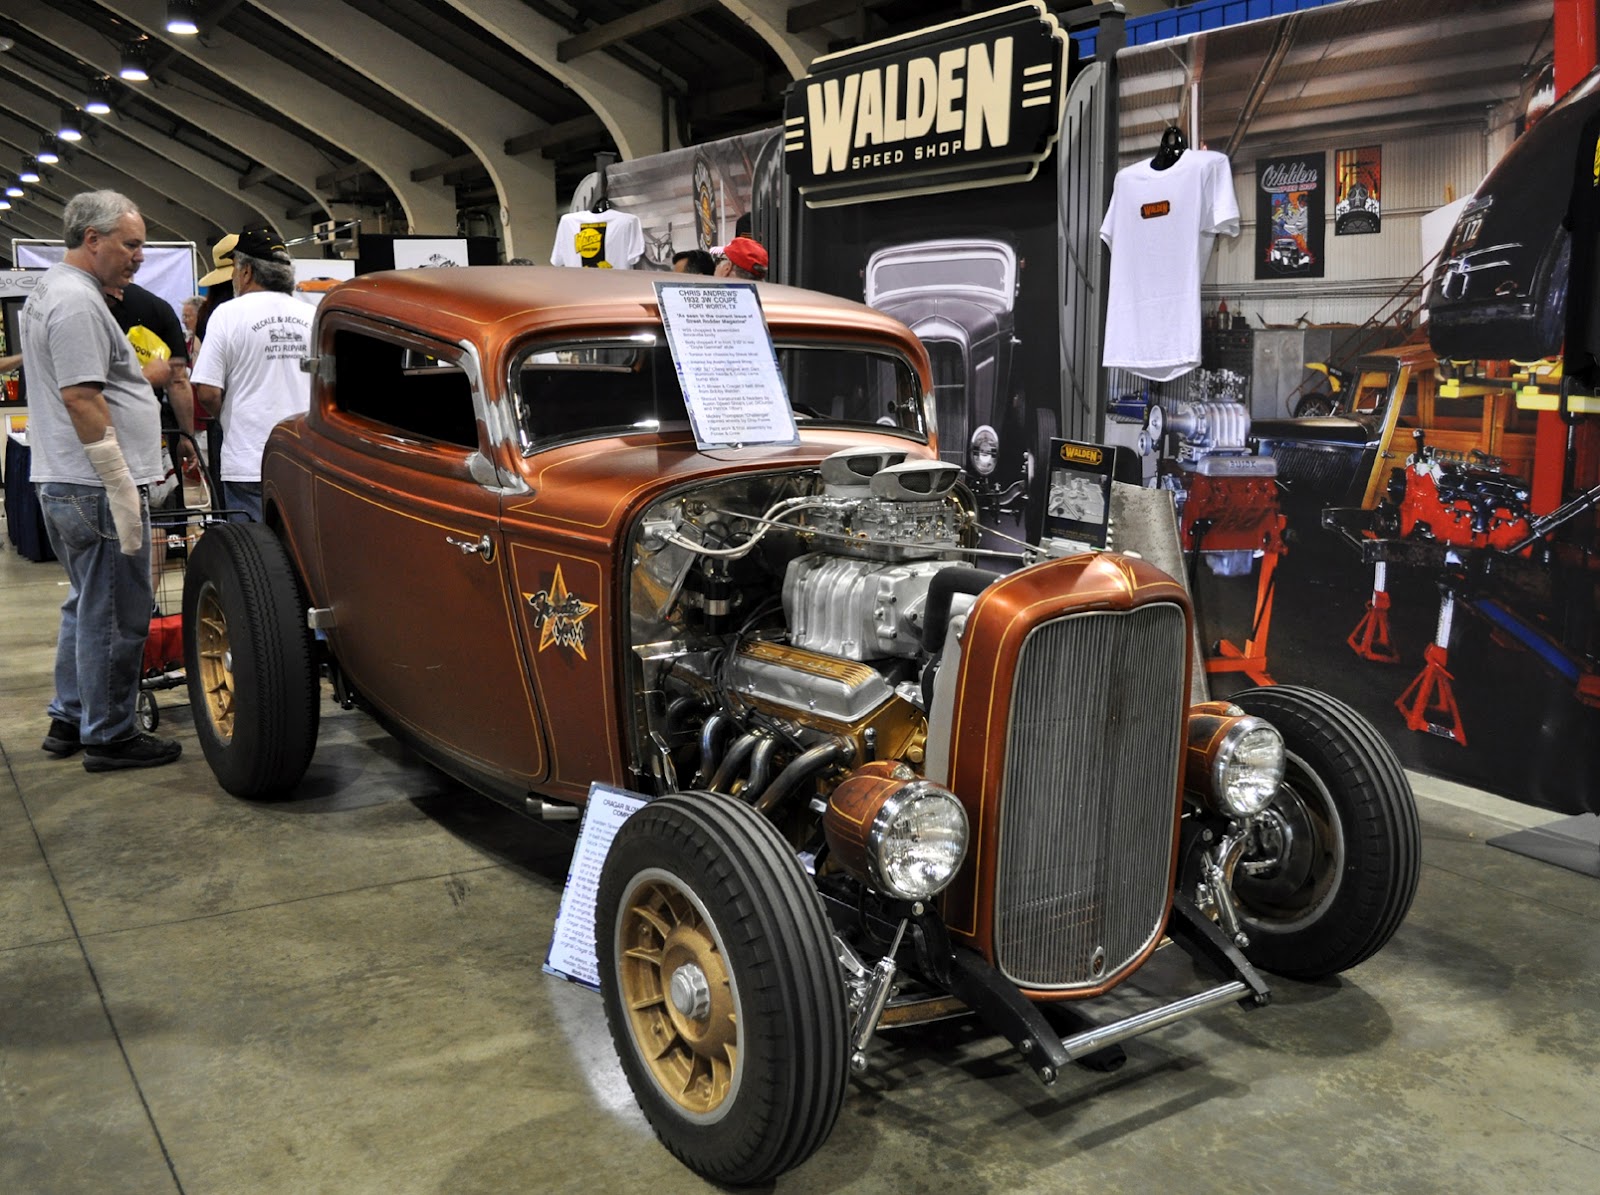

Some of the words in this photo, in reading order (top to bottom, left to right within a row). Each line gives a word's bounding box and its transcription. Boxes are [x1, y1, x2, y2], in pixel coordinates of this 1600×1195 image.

[807, 36, 1013, 175] WALDEN
[852, 150, 903, 169] SPEED
[915, 140, 961, 160] SHOP
[252, 317, 276, 332] HECKLE
[1065, 446, 1097, 461] WALDEN
[603, 799, 624, 810] CRAGAR
